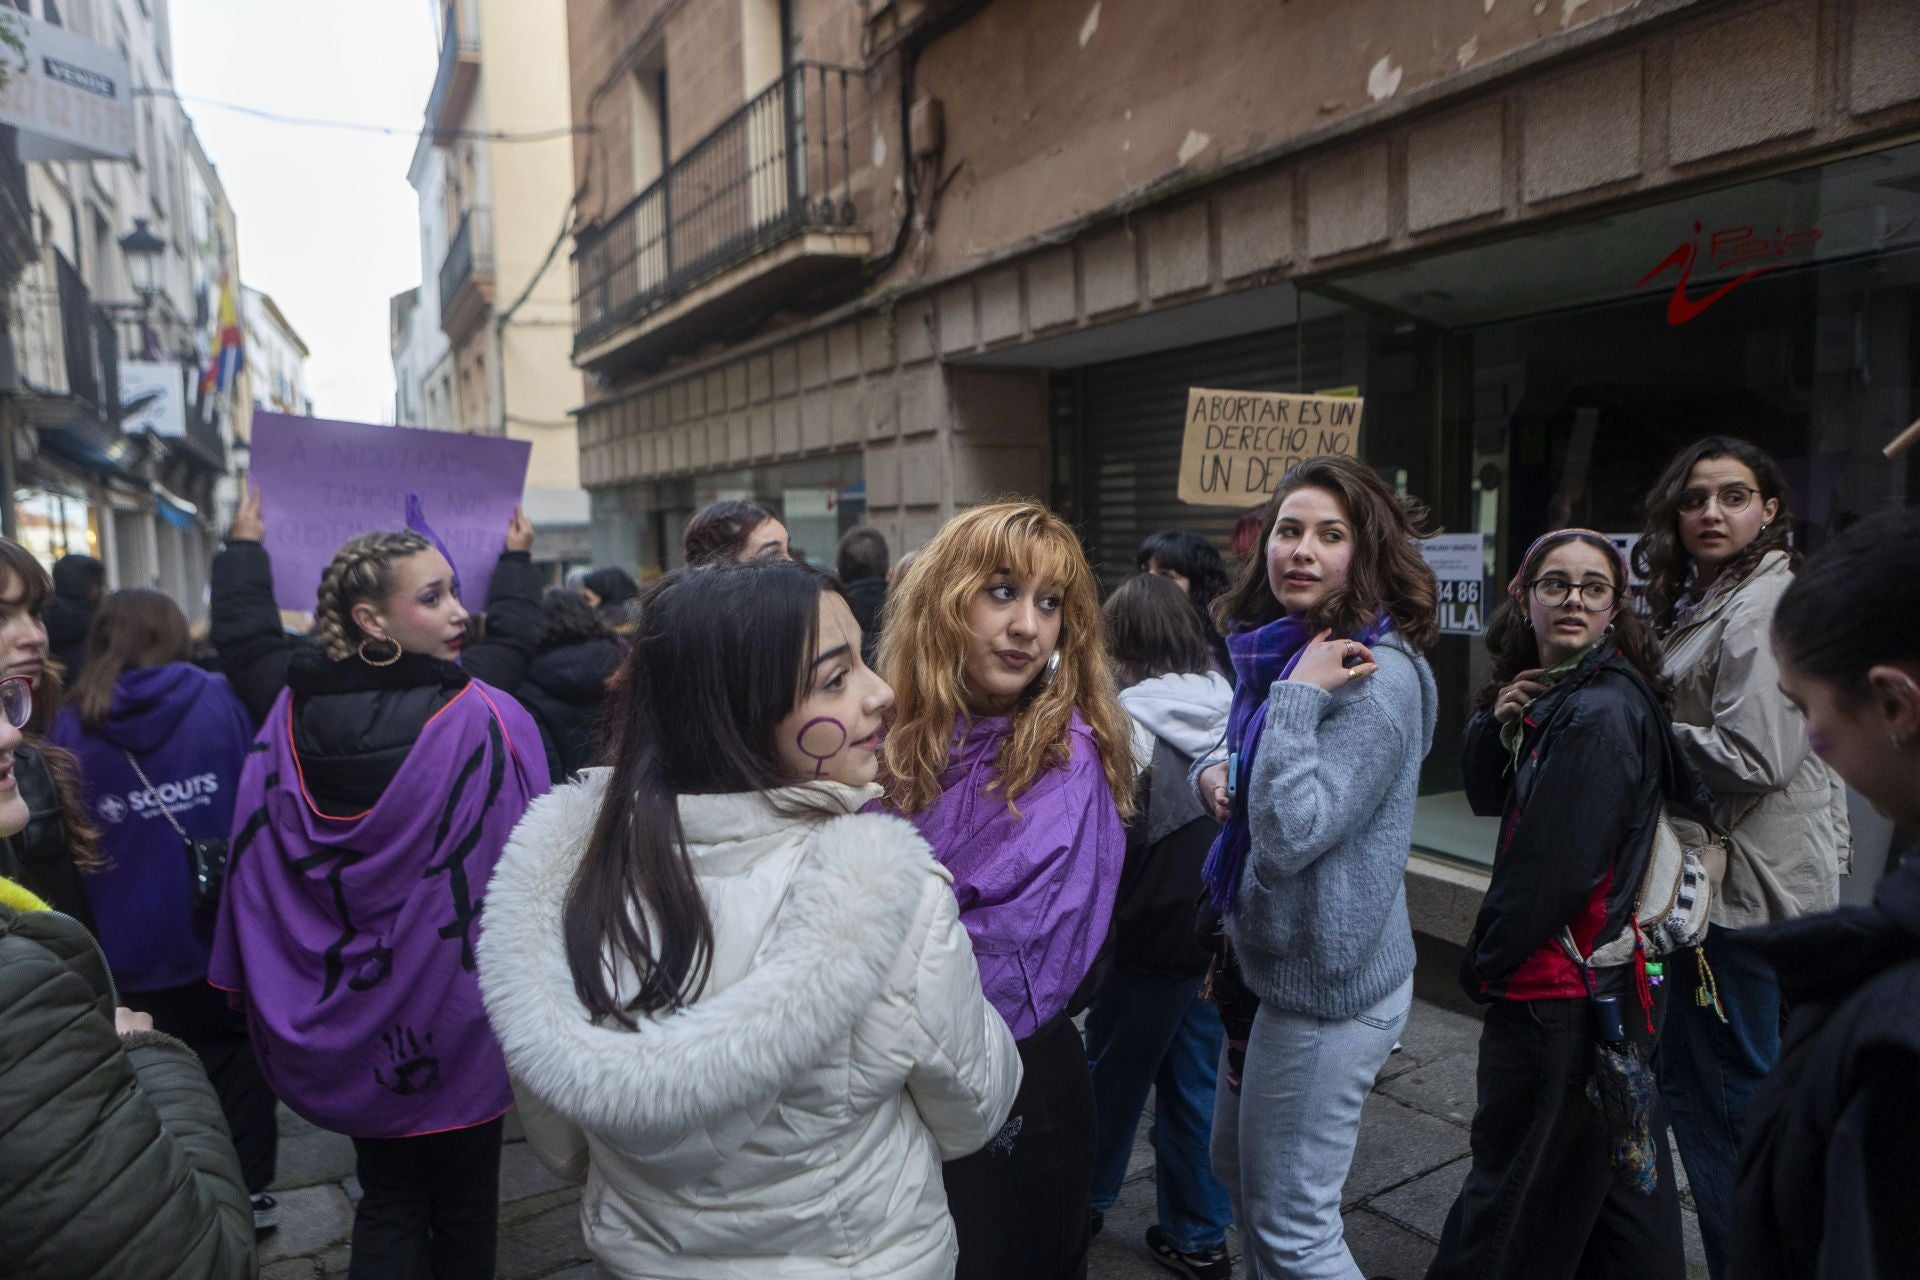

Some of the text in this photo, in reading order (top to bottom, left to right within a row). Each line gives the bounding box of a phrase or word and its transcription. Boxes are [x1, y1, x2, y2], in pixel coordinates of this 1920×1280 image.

[1193, 396, 1356, 427] ABORTAR ES UN
[1317, 431, 1350, 455] NO
[1200, 455, 1232, 493] UN
[1458, 581, 1479, 603] 86
[128, 773, 218, 810] SCOUTS
